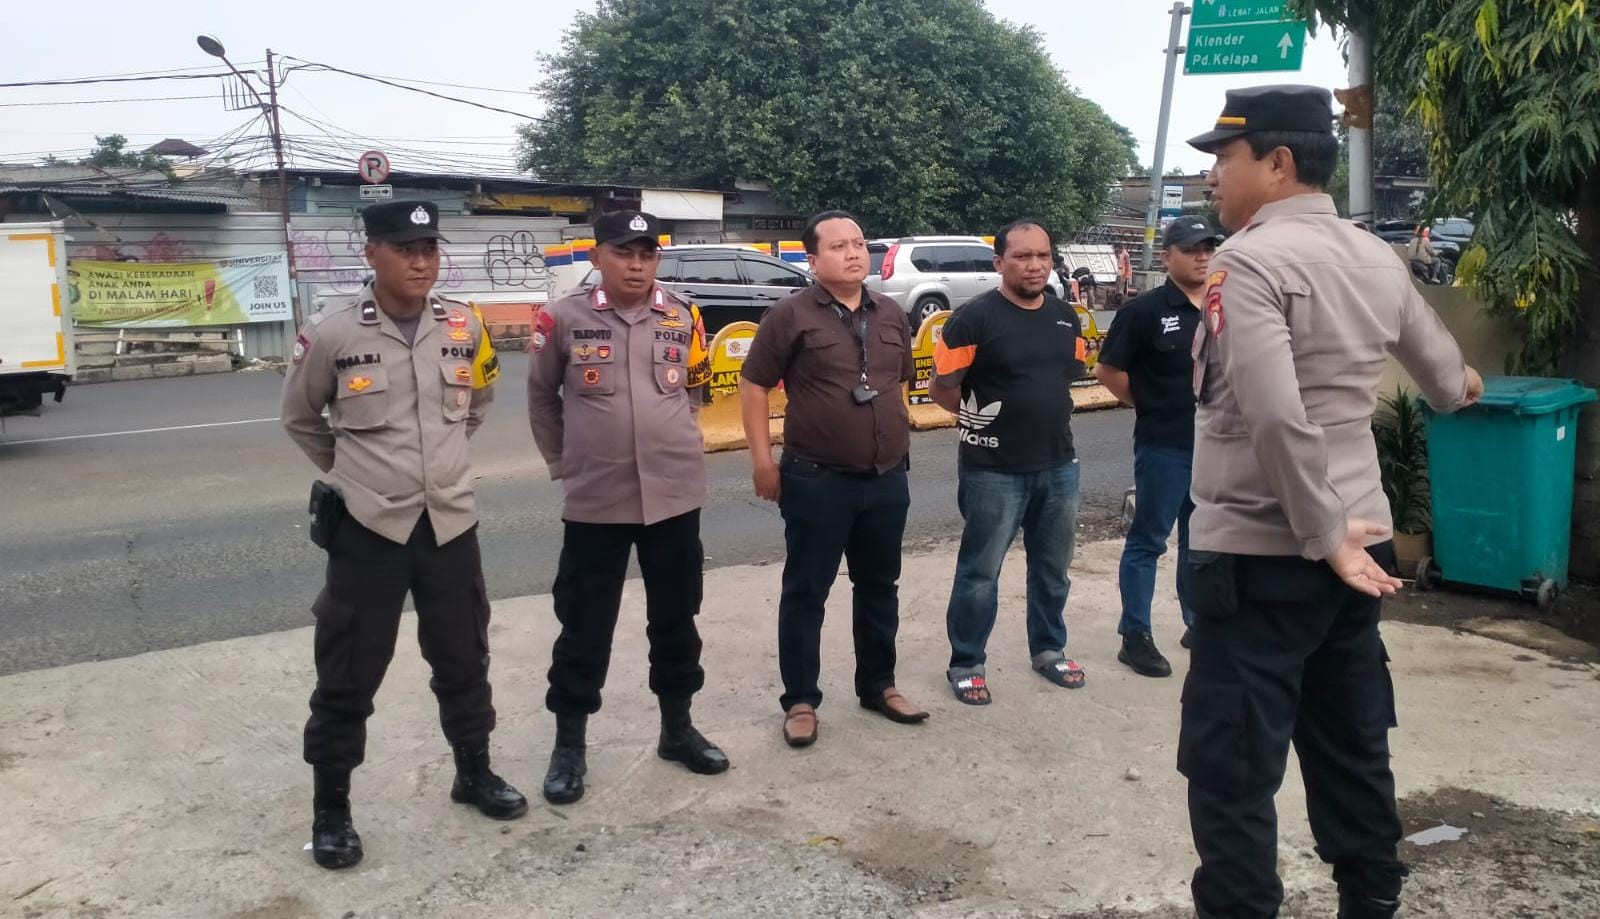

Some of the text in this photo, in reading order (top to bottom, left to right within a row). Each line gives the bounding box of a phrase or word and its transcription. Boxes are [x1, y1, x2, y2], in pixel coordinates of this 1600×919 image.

[1195, 34, 1245, 47] Klender
[88, 270, 195, 279] AWASI KEBERADAAN
[89, 280, 152, 289] ANAK ANDA
[88, 289, 192, 300] DI MALAM HARI
[249, 303, 272, 311] JOIN
[654, 330, 687, 344] POLRI
